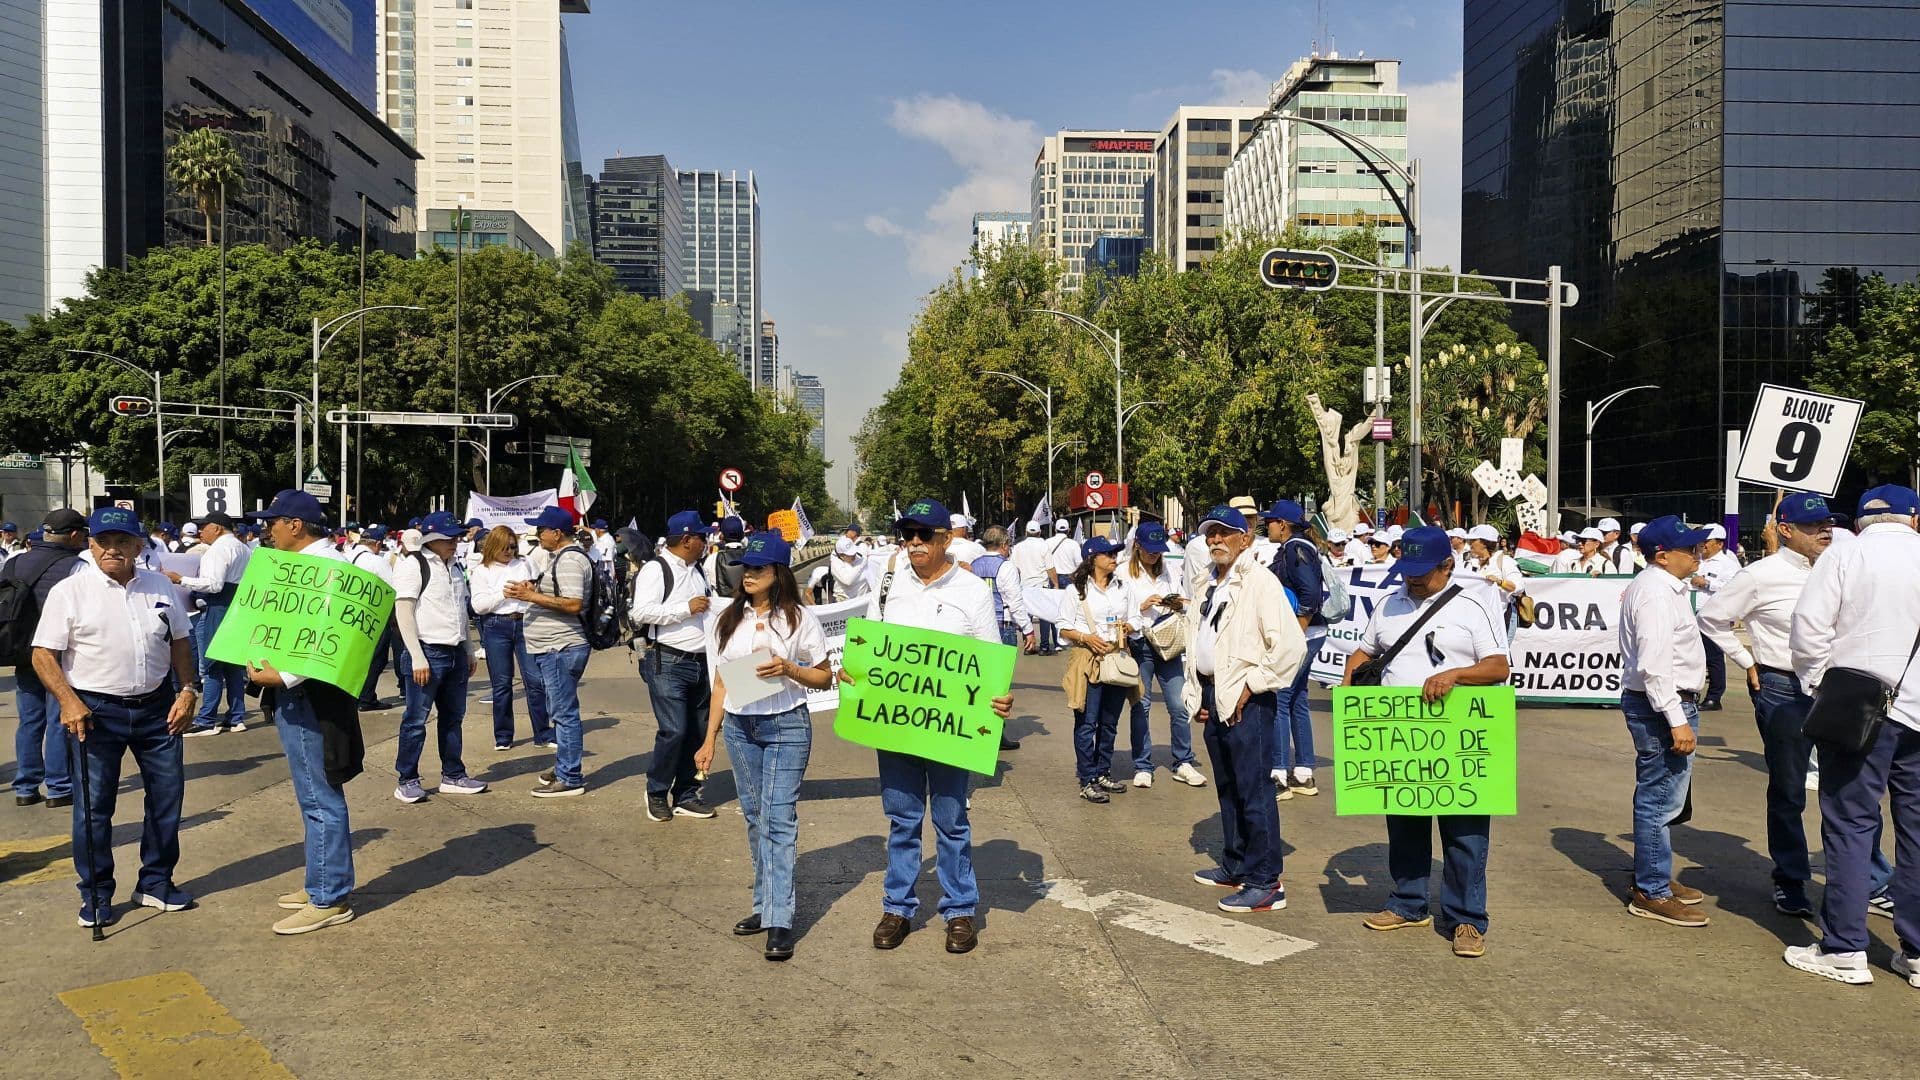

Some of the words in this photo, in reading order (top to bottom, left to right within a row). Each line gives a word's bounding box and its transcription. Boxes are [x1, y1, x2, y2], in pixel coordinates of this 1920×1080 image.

[1098, 141, 1152, 150] MAPFRE
[1782, 396, 1835, 424] BLOQUE
[1770, 421, 1821, 482] 9
[203, 478, 228, 487] BLOQUE
[206, 488, 227, 513] 8
[273, 562, 383, 608] SEGURIDAD
[239, 584, 331, 617] JURÍDICA
[340, 604, 381, 640] BASE
[250, 624, 282, 650] DEL
[293, 626, 341, 656] PAÍS
[873, 635, 981, 678] JUSTICIA
[1524, 651, 1625, 670] NACION
[867, 667, 948, 698] SOCIAL
[965, 684, 981, 705] Y
[856, 698, 973, 739] LABORAL
[1343, 695, 1446, 719] RESPETO
[1468, 697, 1495, 718] AL
[1343, 725, 1446, 752] ESTADO
[1459, 729, 1489, 751] DE
[1343, 757, 1450, 782] DERECHO
[1461, 758, 1487, 778] DE
[1374, 782, 1478, 809] TODOS
